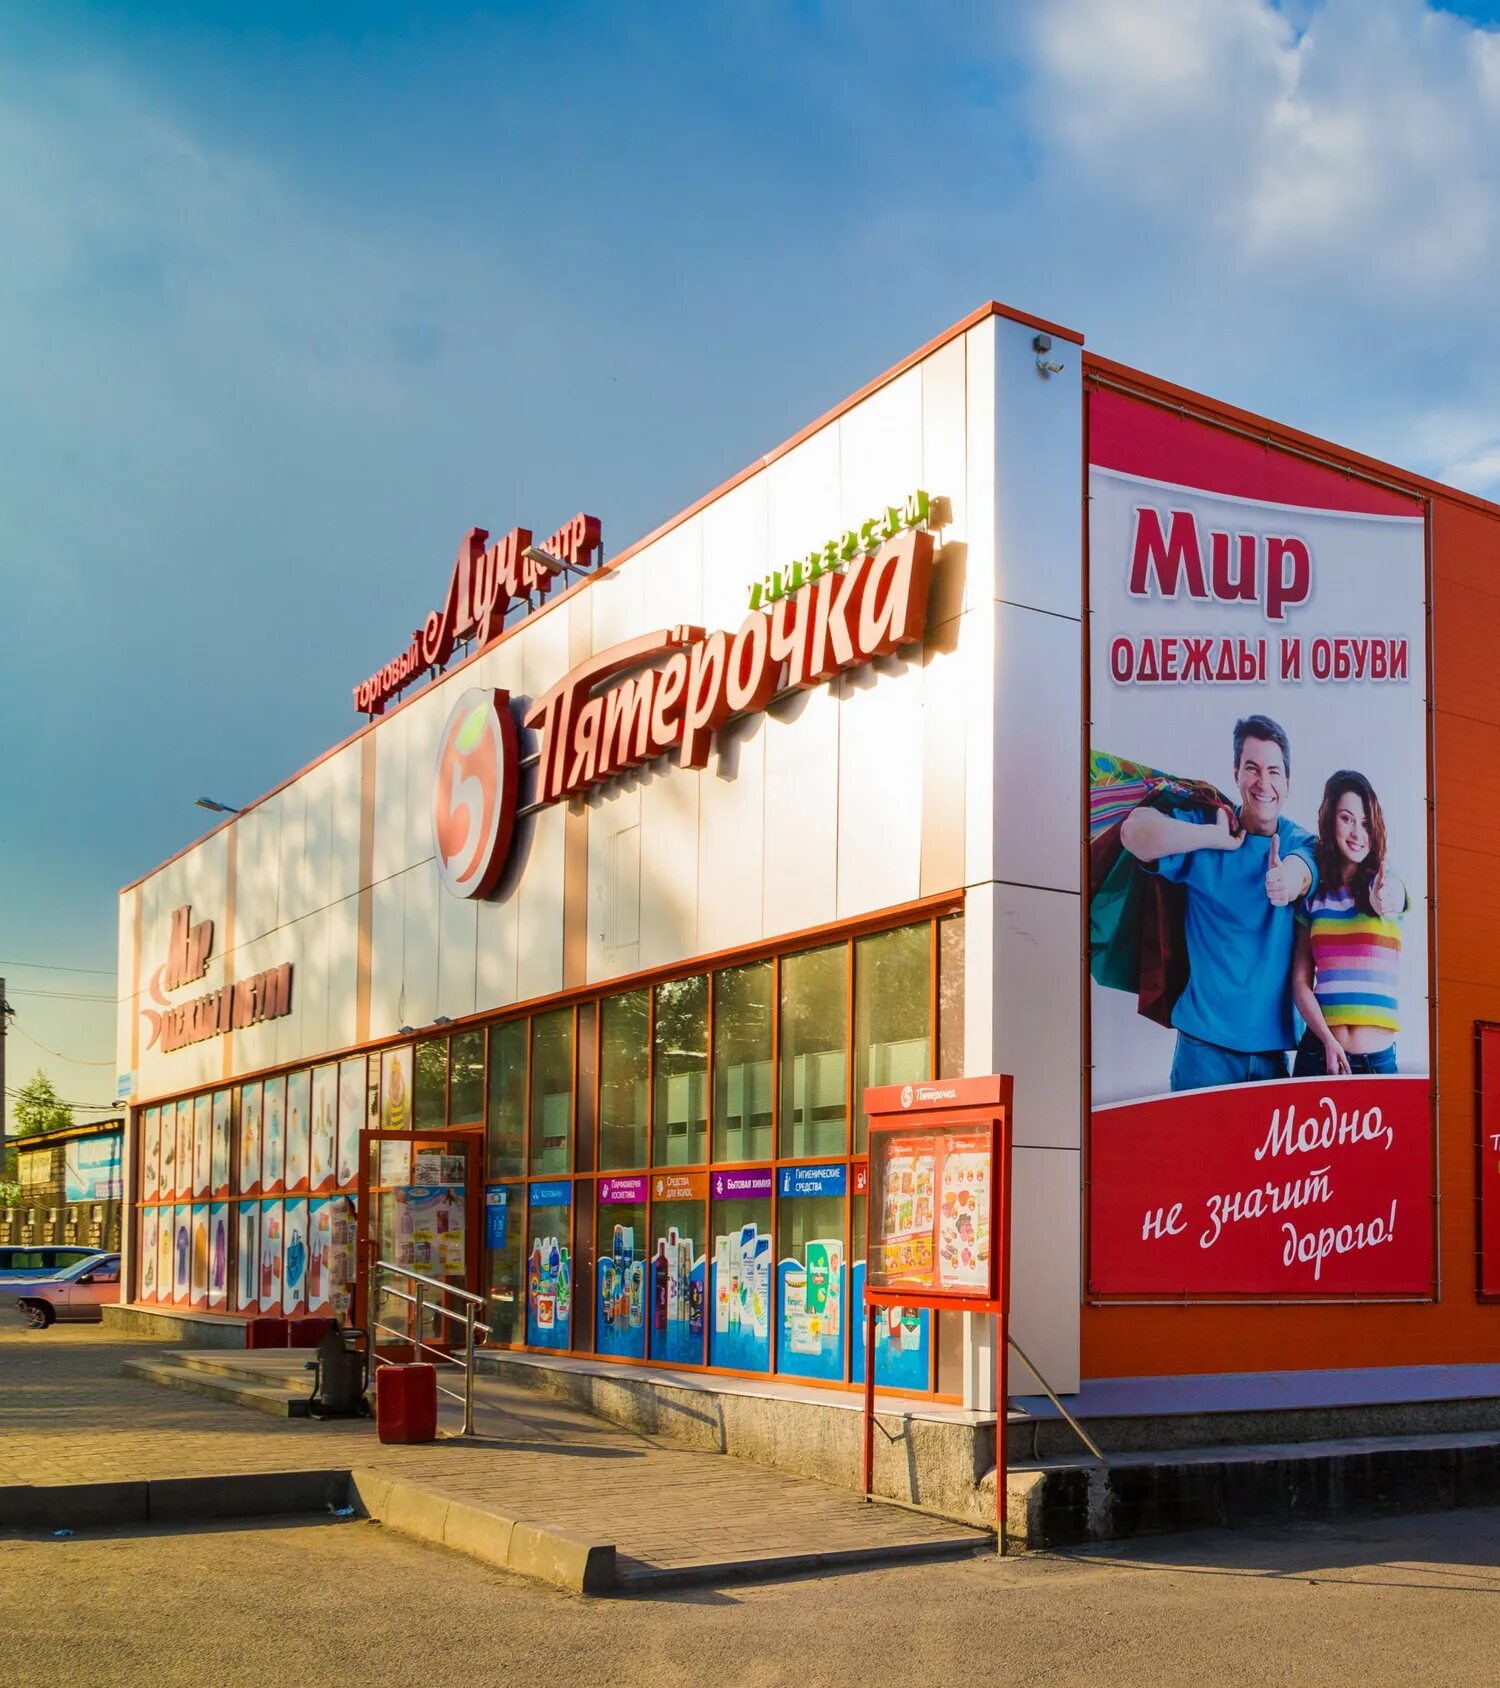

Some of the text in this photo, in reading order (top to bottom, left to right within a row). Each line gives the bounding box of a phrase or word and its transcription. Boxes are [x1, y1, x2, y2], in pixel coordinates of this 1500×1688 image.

[747, 489, 928, 609] УНИВЕРСАМ
[1128, 507, 1311, 620] Мир
[524, 530, 928, 803] Пятёрочка
[1111, 637, 1409, 682] ОДЕЖДЫ И ОБУВИ
[1254, 1096, 1394, 1161] Модно,
[1141, 1164, 1334, 1250] не значит
[1281, 1199, 1398, 1281] дорого!
